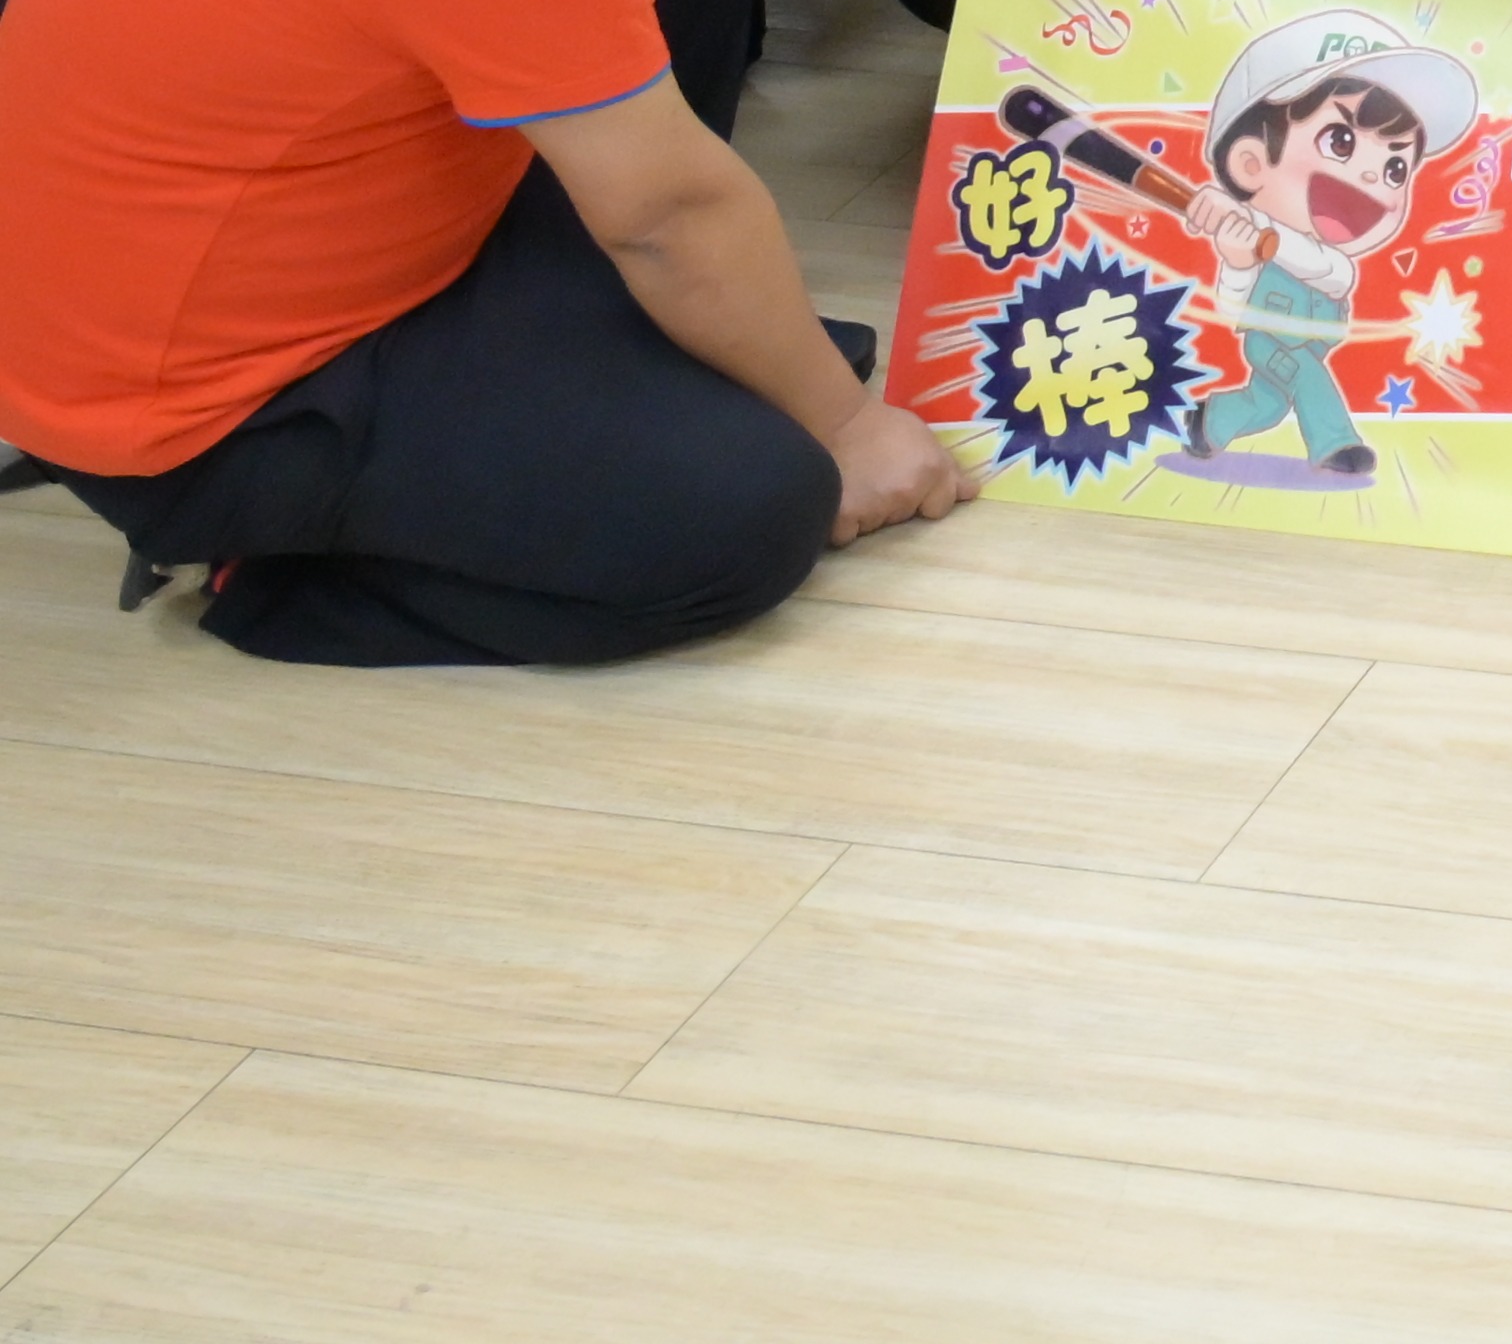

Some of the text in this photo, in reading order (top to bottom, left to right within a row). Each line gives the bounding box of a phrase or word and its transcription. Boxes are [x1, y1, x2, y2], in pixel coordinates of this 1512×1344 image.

[1315, 32, 1391, 63] PO
[960, 146, 1072, 266] 好
[1008, 284, 1160, 442] 棒
